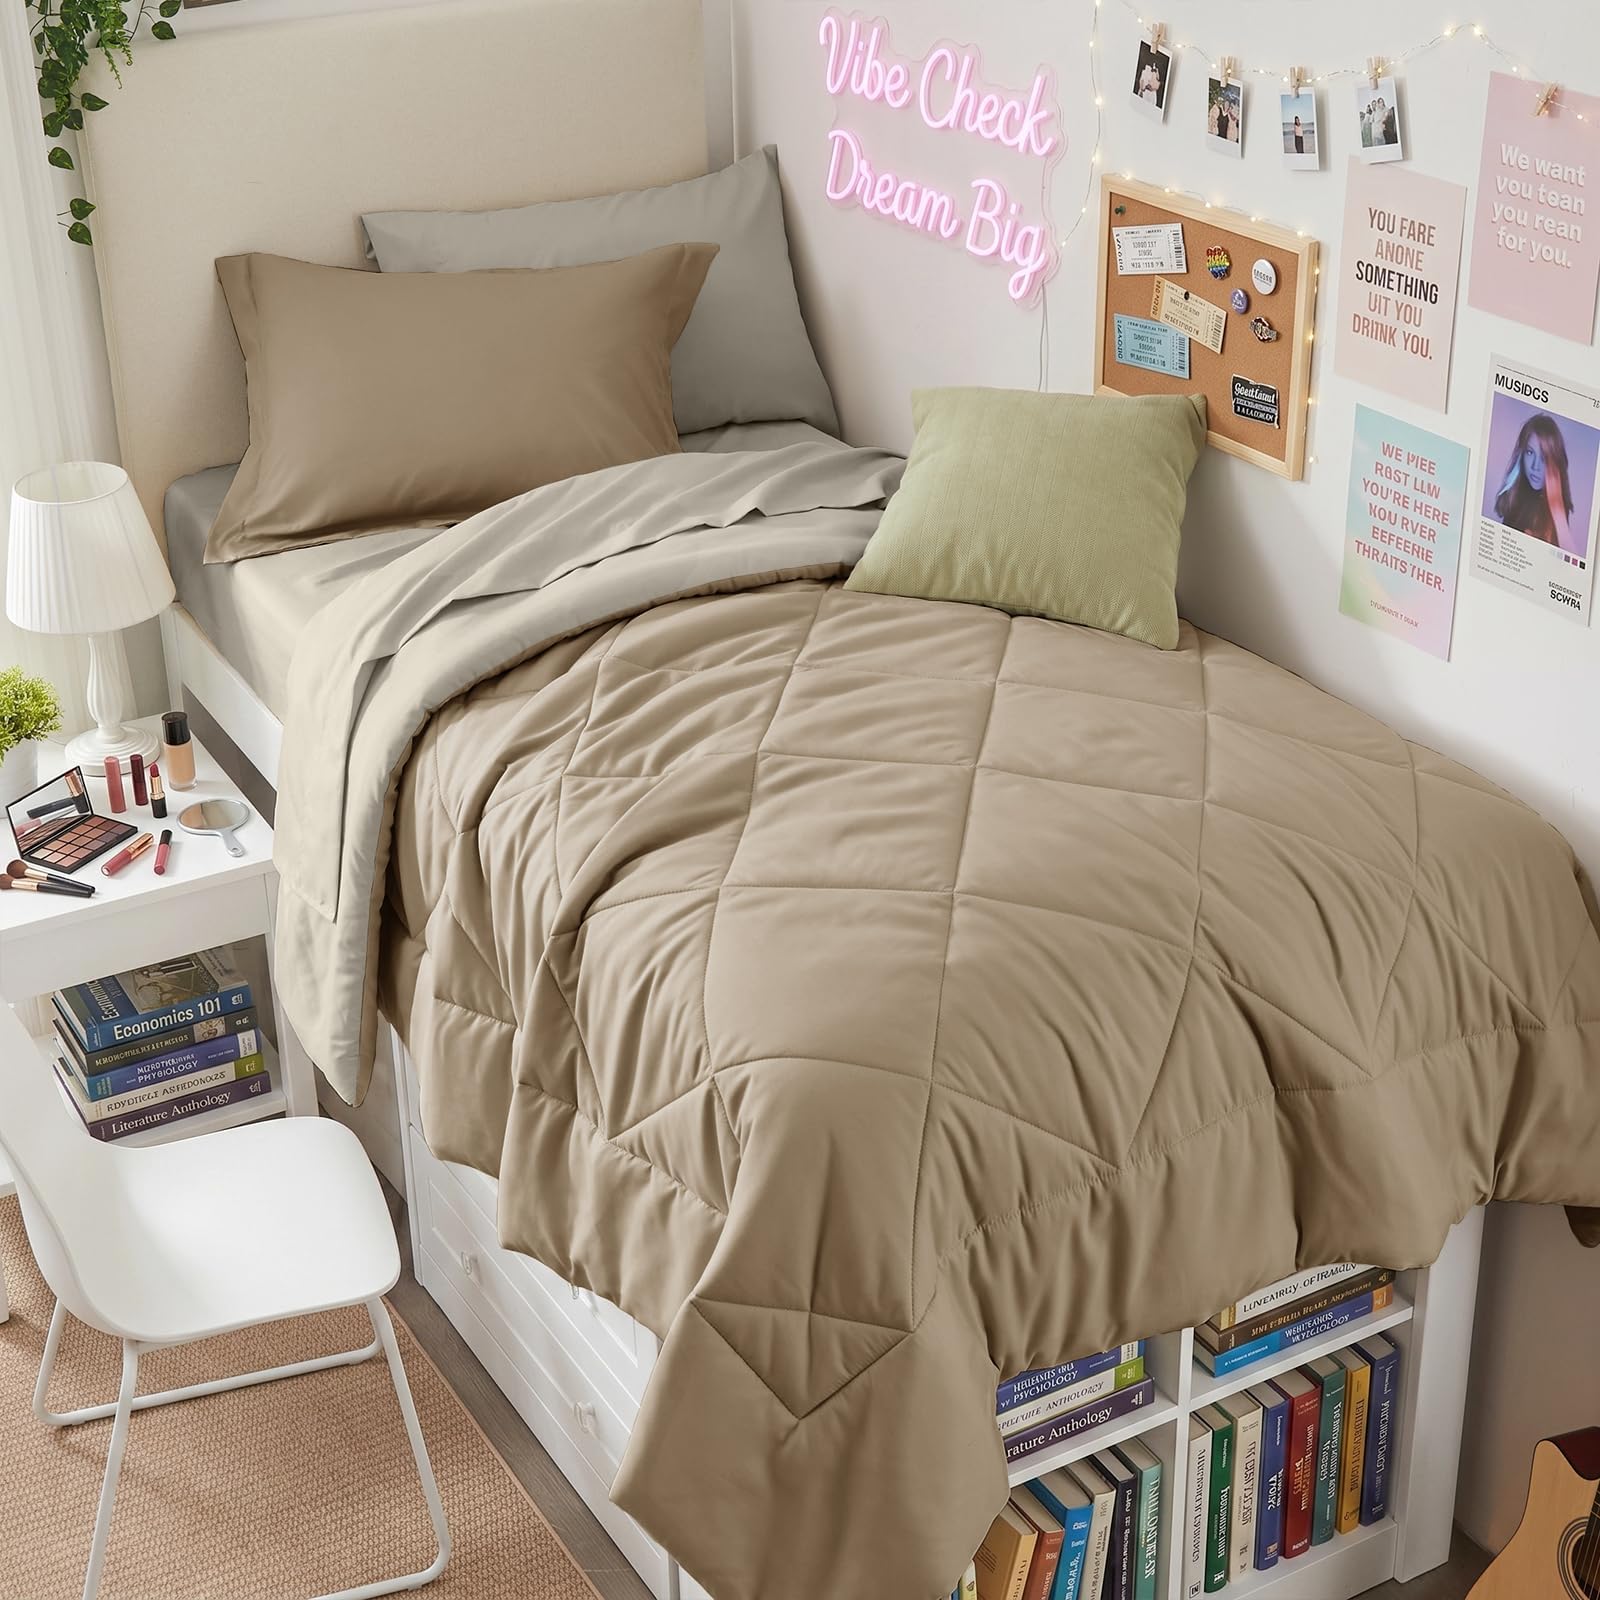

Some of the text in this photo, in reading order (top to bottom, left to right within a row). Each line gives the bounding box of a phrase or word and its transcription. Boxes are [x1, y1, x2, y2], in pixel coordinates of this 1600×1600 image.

[819, 15, 1055, 156] Vibe Check
[1501, 143, 1585, 187] We want
[826, 129, 1046, 299] Dream Big
[1368, 207, 1436, 247] YOU FARE
[1491, 201, 1582, 243] you rean
[1375, 238, 1424, 272] ANONE
[1497, 225, 1572, 269] for you.
[1356, 260, 1439, 304] SOMETHING
[1395, 300, 1423, 328] YOU
[1402, 330, 1432, 360] YOU.
[1382, 441, 1403, 462] WE
[1362, 478, 1449, 527] YOU'RE HERE
[113, 997, 221, 1040] Economics 101
[111, 1110, 168, 1134] Literature
[171, 1091, 231, 1116] Anthology
[1049, 1406, 1112, 1440] Anthology
